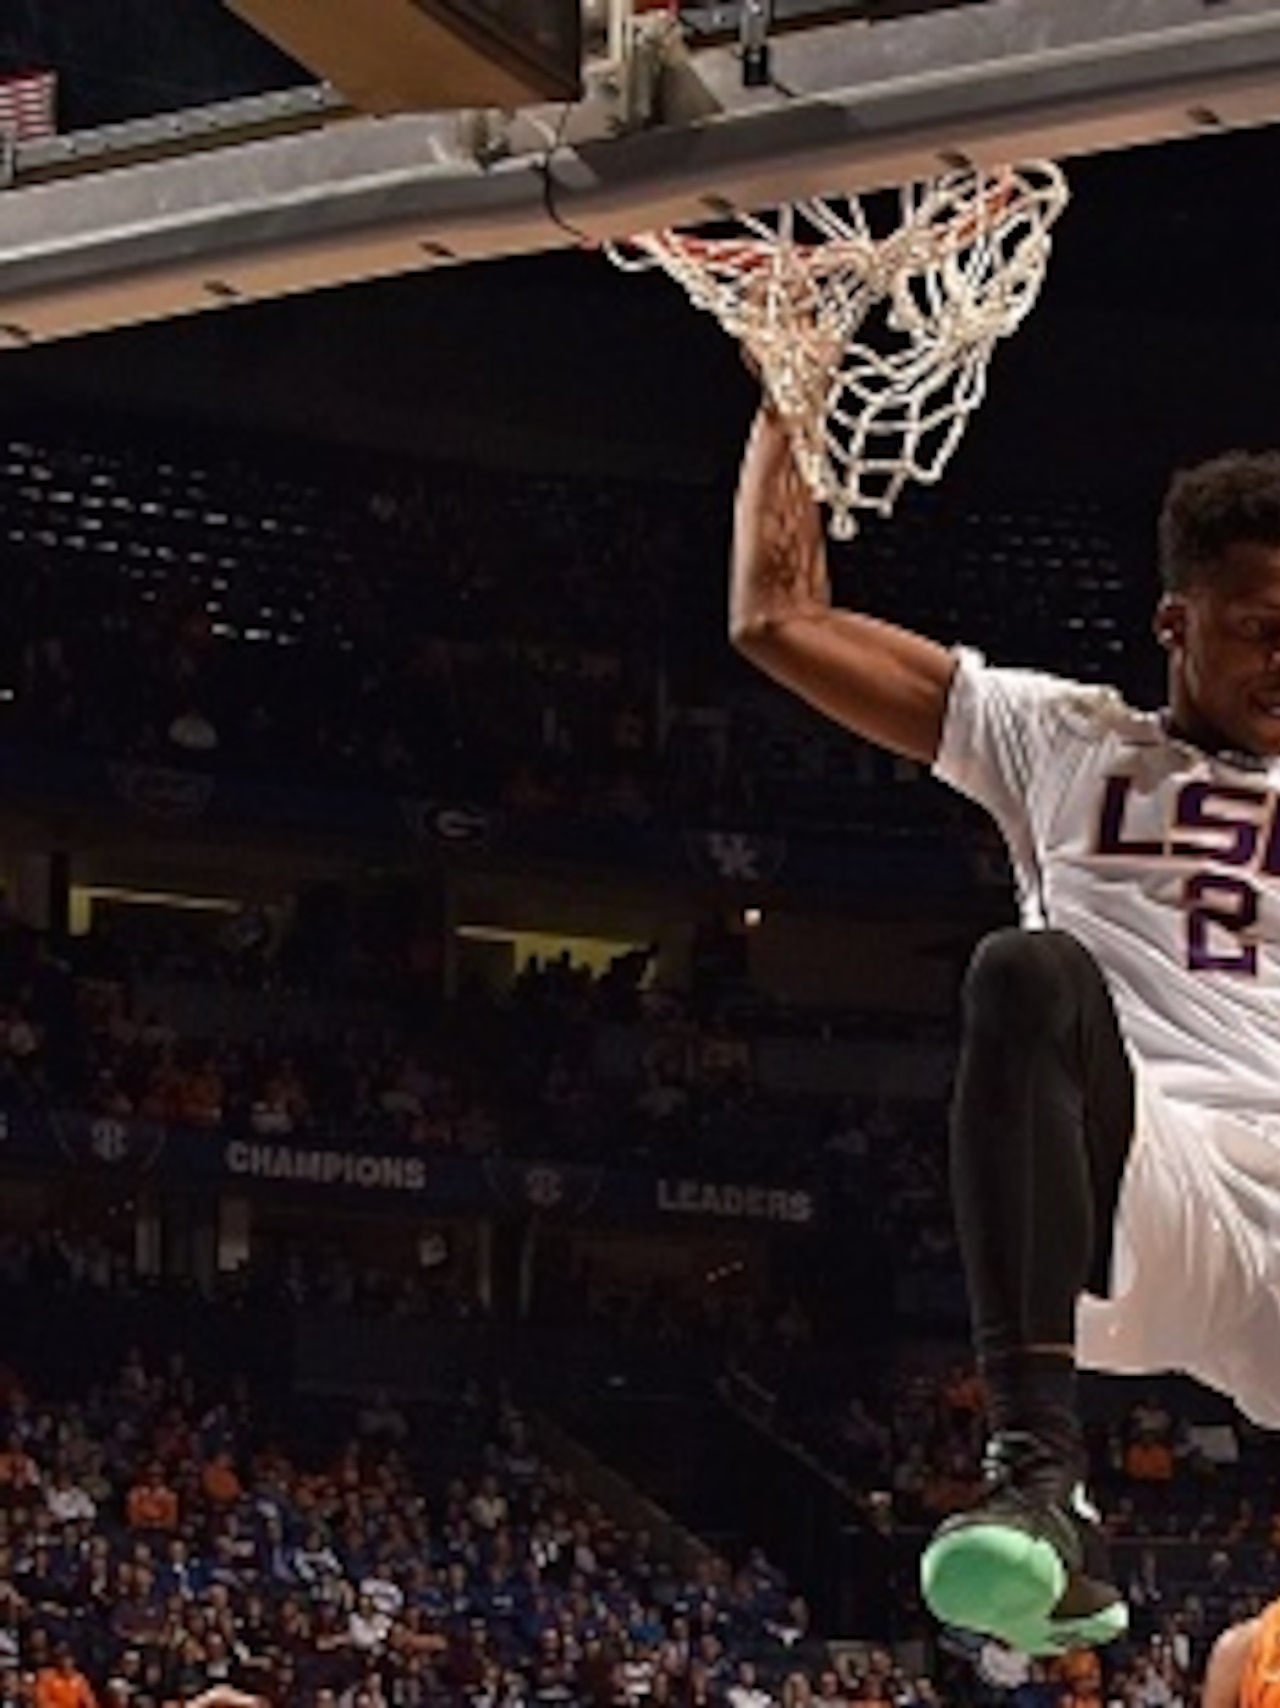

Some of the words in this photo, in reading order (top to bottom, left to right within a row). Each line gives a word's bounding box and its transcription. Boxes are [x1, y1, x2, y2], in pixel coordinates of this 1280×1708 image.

[1184, 873, 1258, 976] 2
[223, 1139, 428, 1190] CHAMPIONS
[656, 1177, 815, 1222] LEADERS
